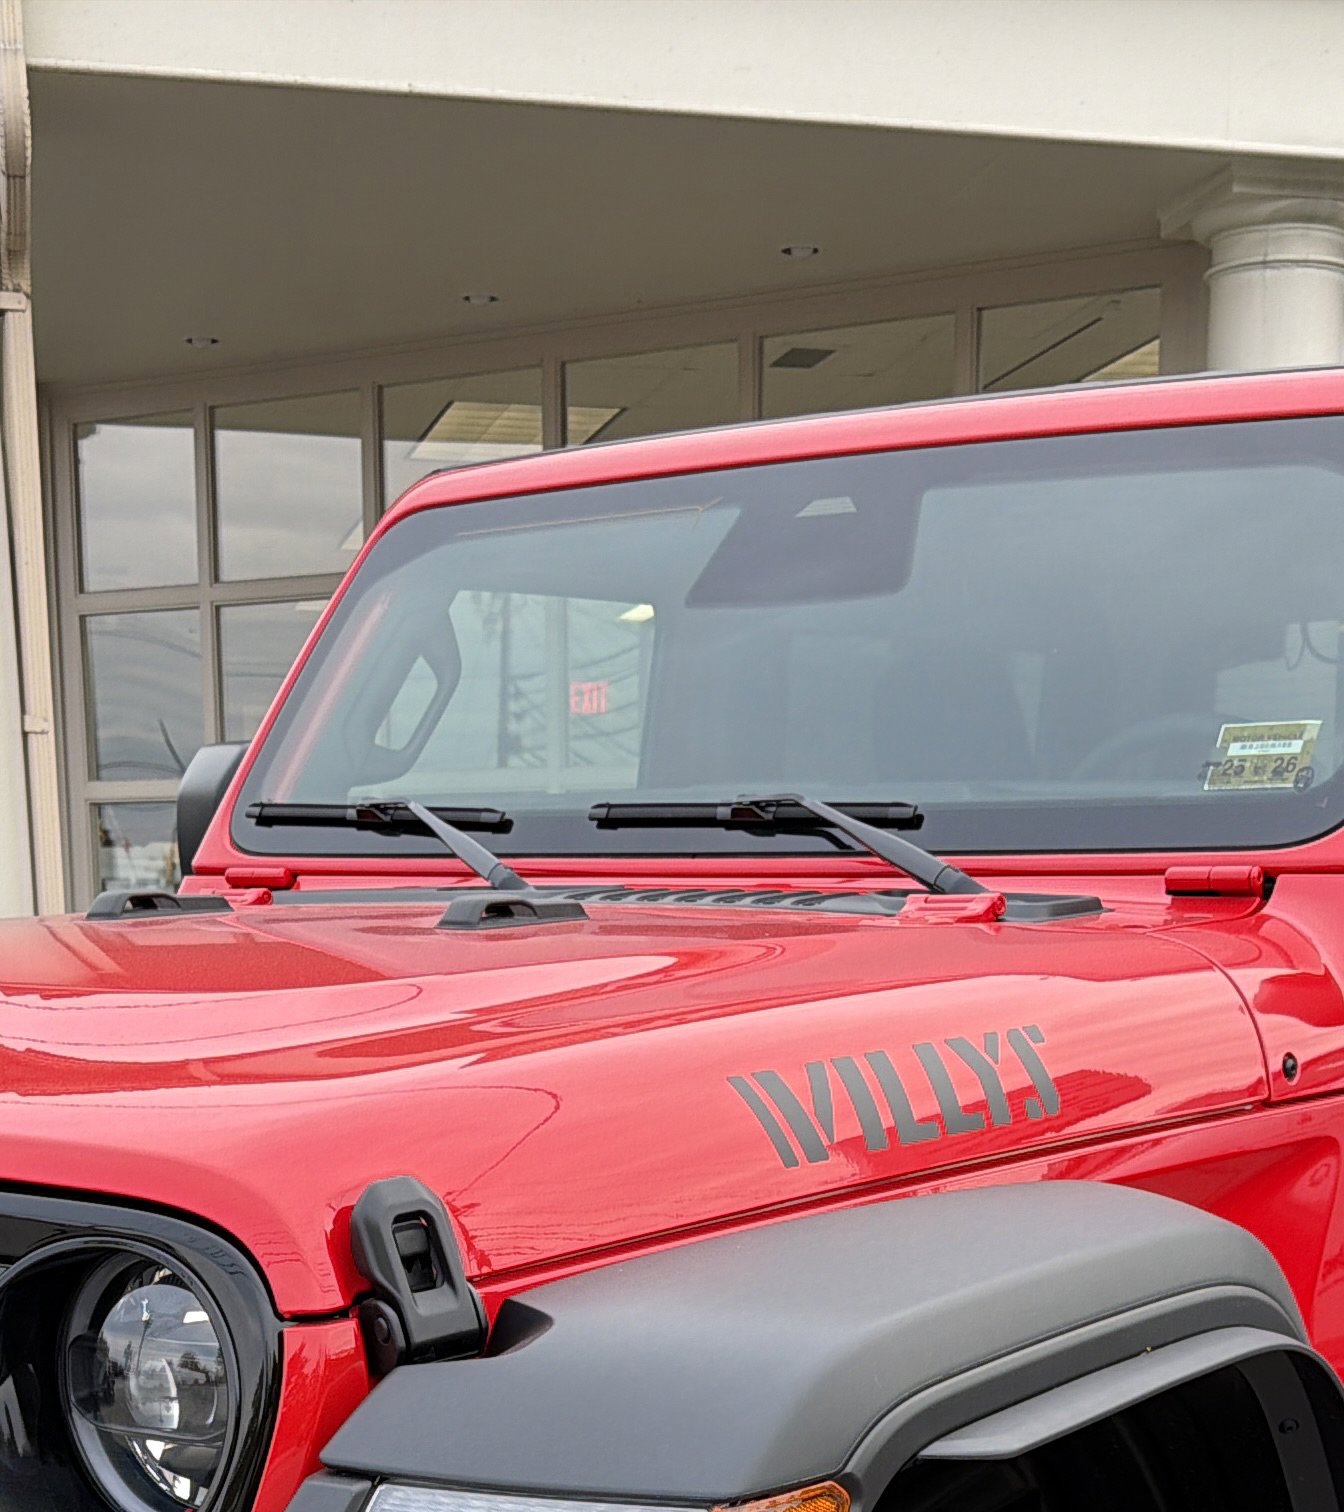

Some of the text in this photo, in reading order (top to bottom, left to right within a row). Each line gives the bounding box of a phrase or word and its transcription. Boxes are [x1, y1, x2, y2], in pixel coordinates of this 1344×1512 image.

[1222, 756, 1298, 776] 25 26
[726, 1025, 1060, 1168] WILLYS
